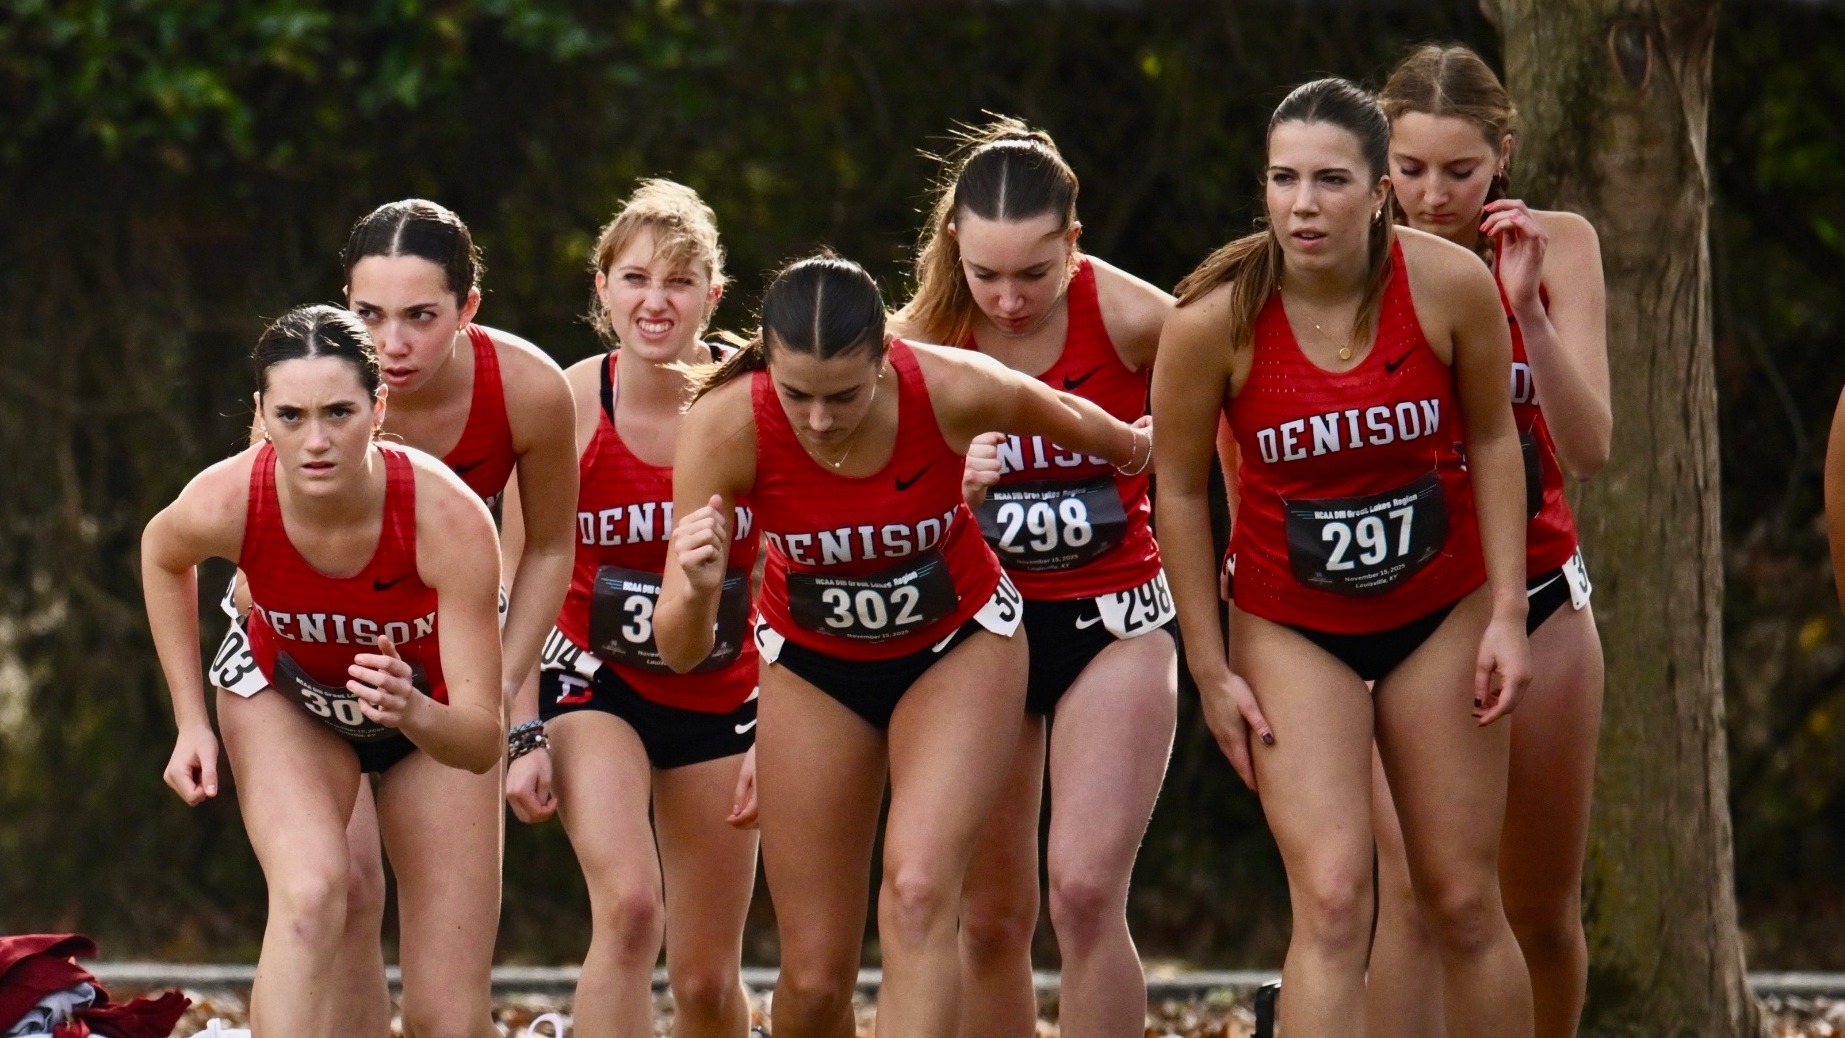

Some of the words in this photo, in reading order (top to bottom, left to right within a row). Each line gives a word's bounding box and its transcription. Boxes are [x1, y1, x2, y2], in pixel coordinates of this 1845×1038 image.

[1257, 399, 1440, 464] DENISON
[577, 501, 753, 547] DENIN
[997, 498, 1093, 553] 298
[1314, 511, 1333, 520] NCAA
[1347, 507, 1369, 518] Great
[1370, 501, 1392, 513] Lakes
[1393, 494, 1418, 507] Region
[1322, 505, 1414, 571] 297
[1345, 572, 1379, 582] November
[1380, 569, 1389, 577] 15,
[1390, 563, 1406, 572] 2025
[822, 585, 923, 630] 302
[1116, 573, 1171, 633] 298
[212, 631, 259, 688] 03
[301, 688, 365, 726] 30
